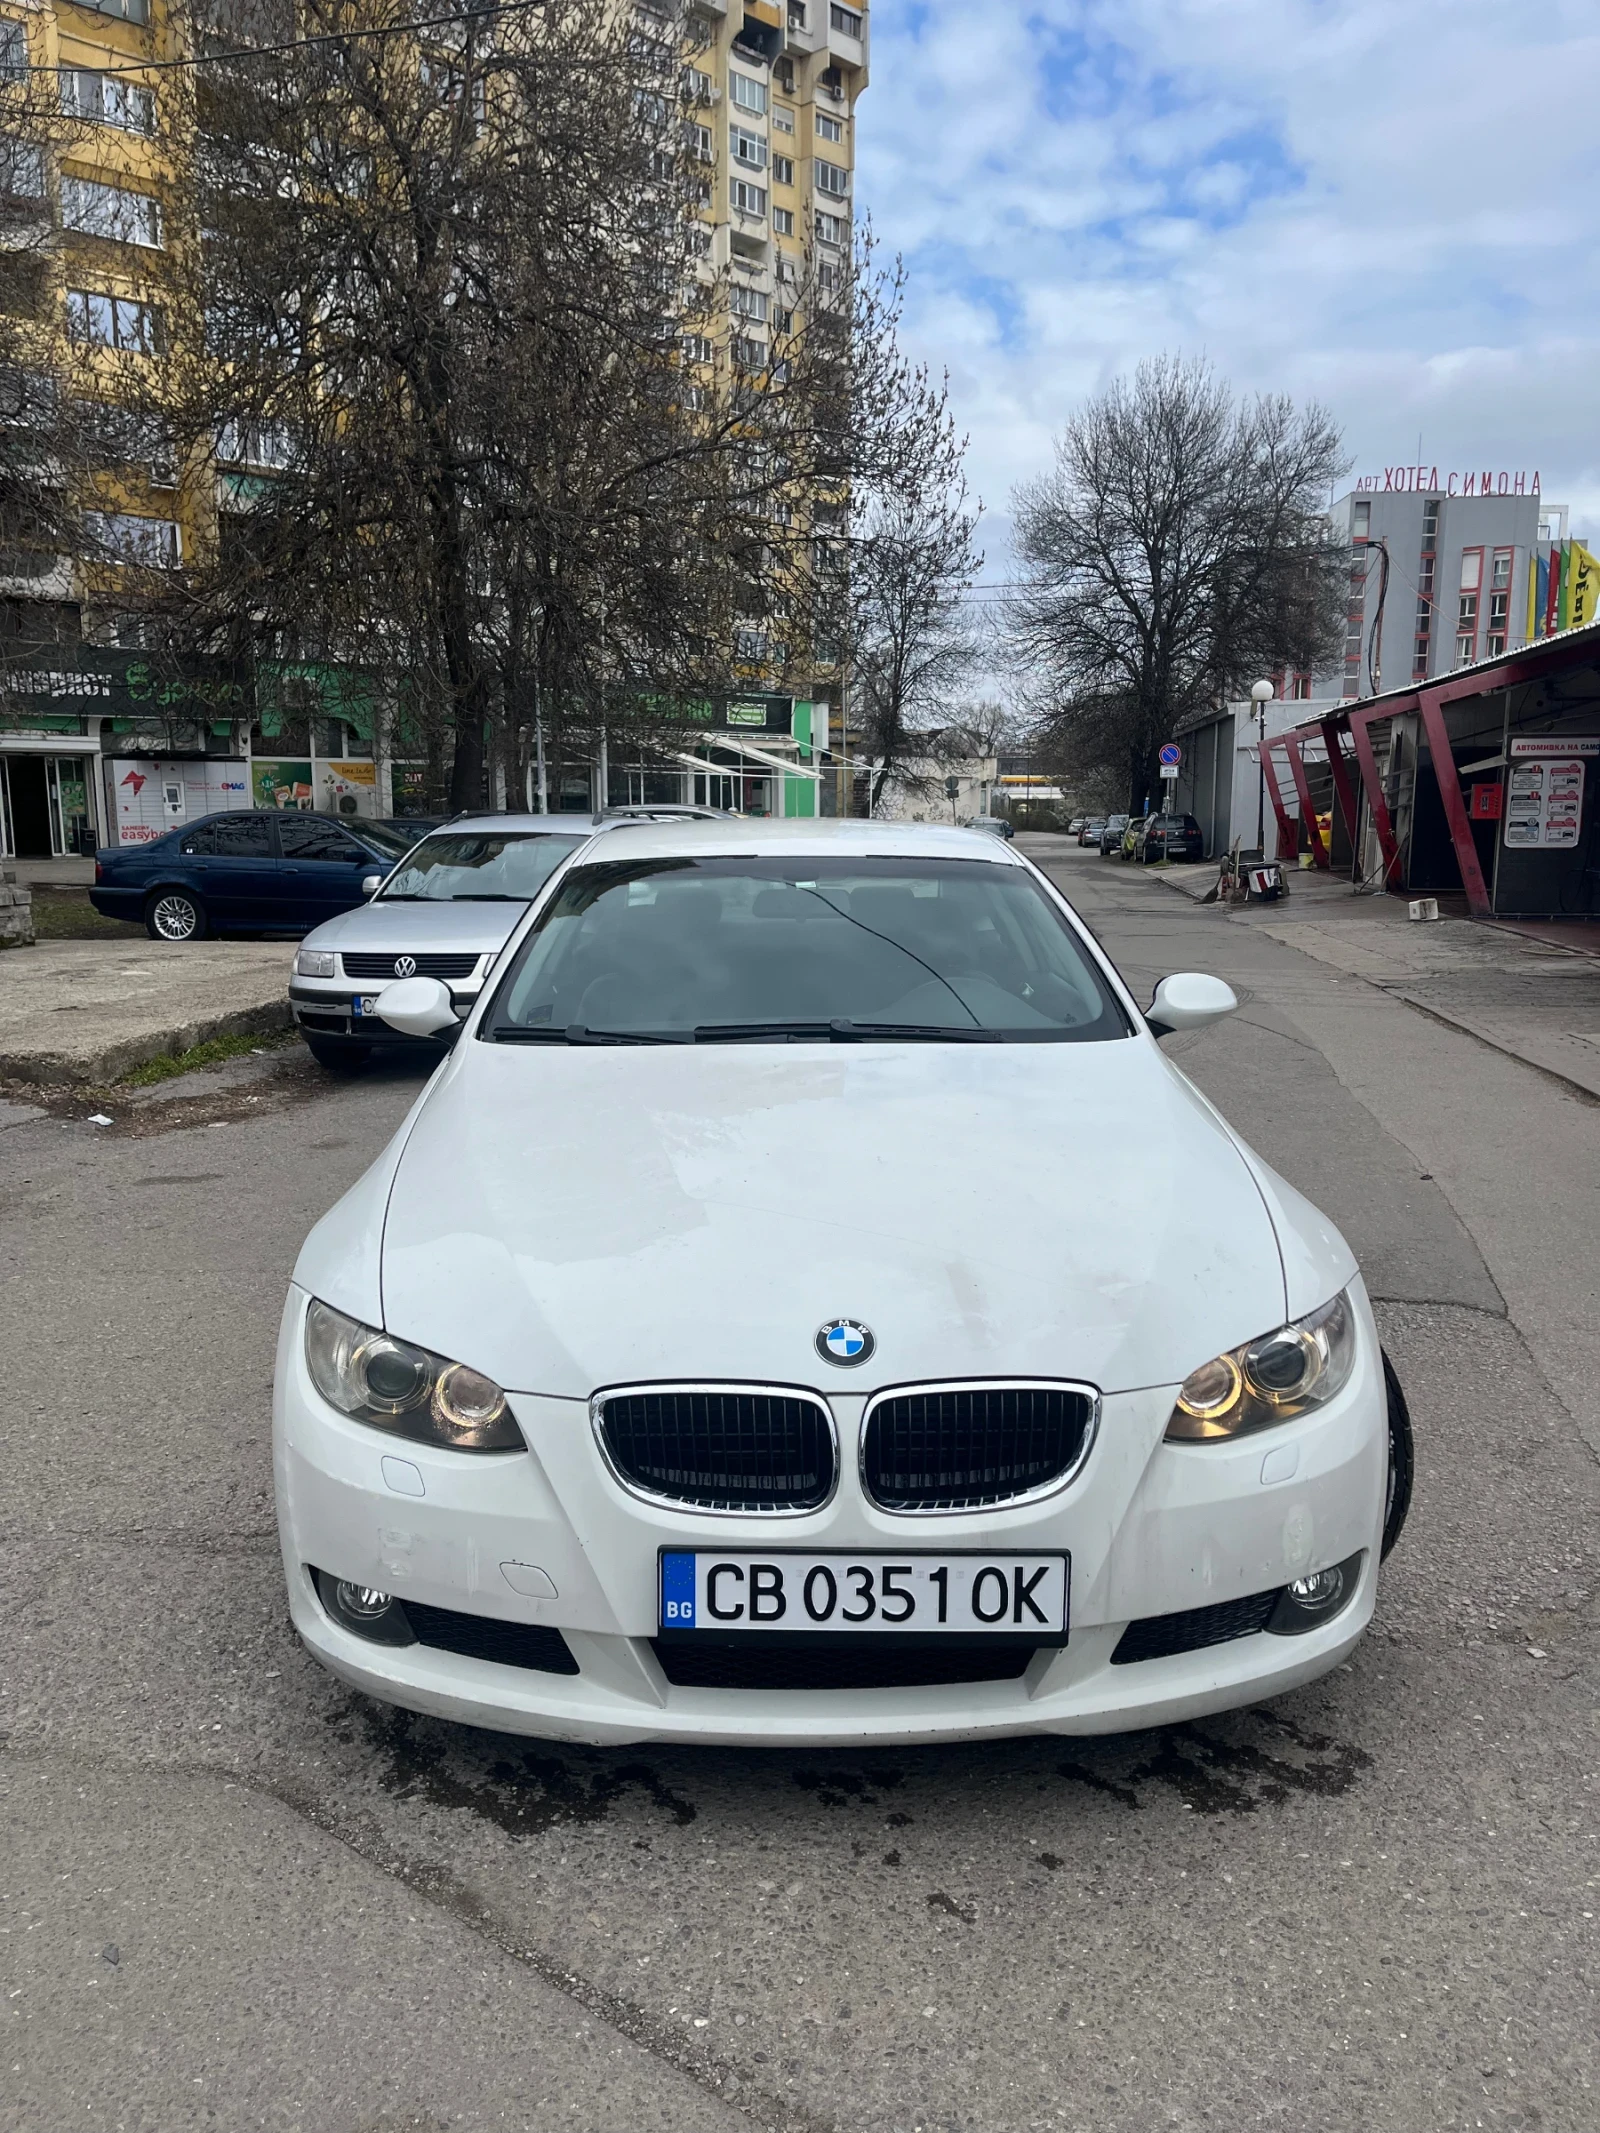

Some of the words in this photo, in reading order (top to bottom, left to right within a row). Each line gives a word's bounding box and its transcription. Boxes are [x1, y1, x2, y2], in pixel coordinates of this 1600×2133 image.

[1356, 475, 1381, 493] АРТ
[1384, 466, 1438, 493] ХОТЕЛ
[1447, 470, 1541, 497] СИМОНА
[121, 829, 166, 842] easybo
[821, 1320, 869, 1334] BMW
[803, 1565, 948, 1622] 0351
[667, 1601, 692, 1619] BG
